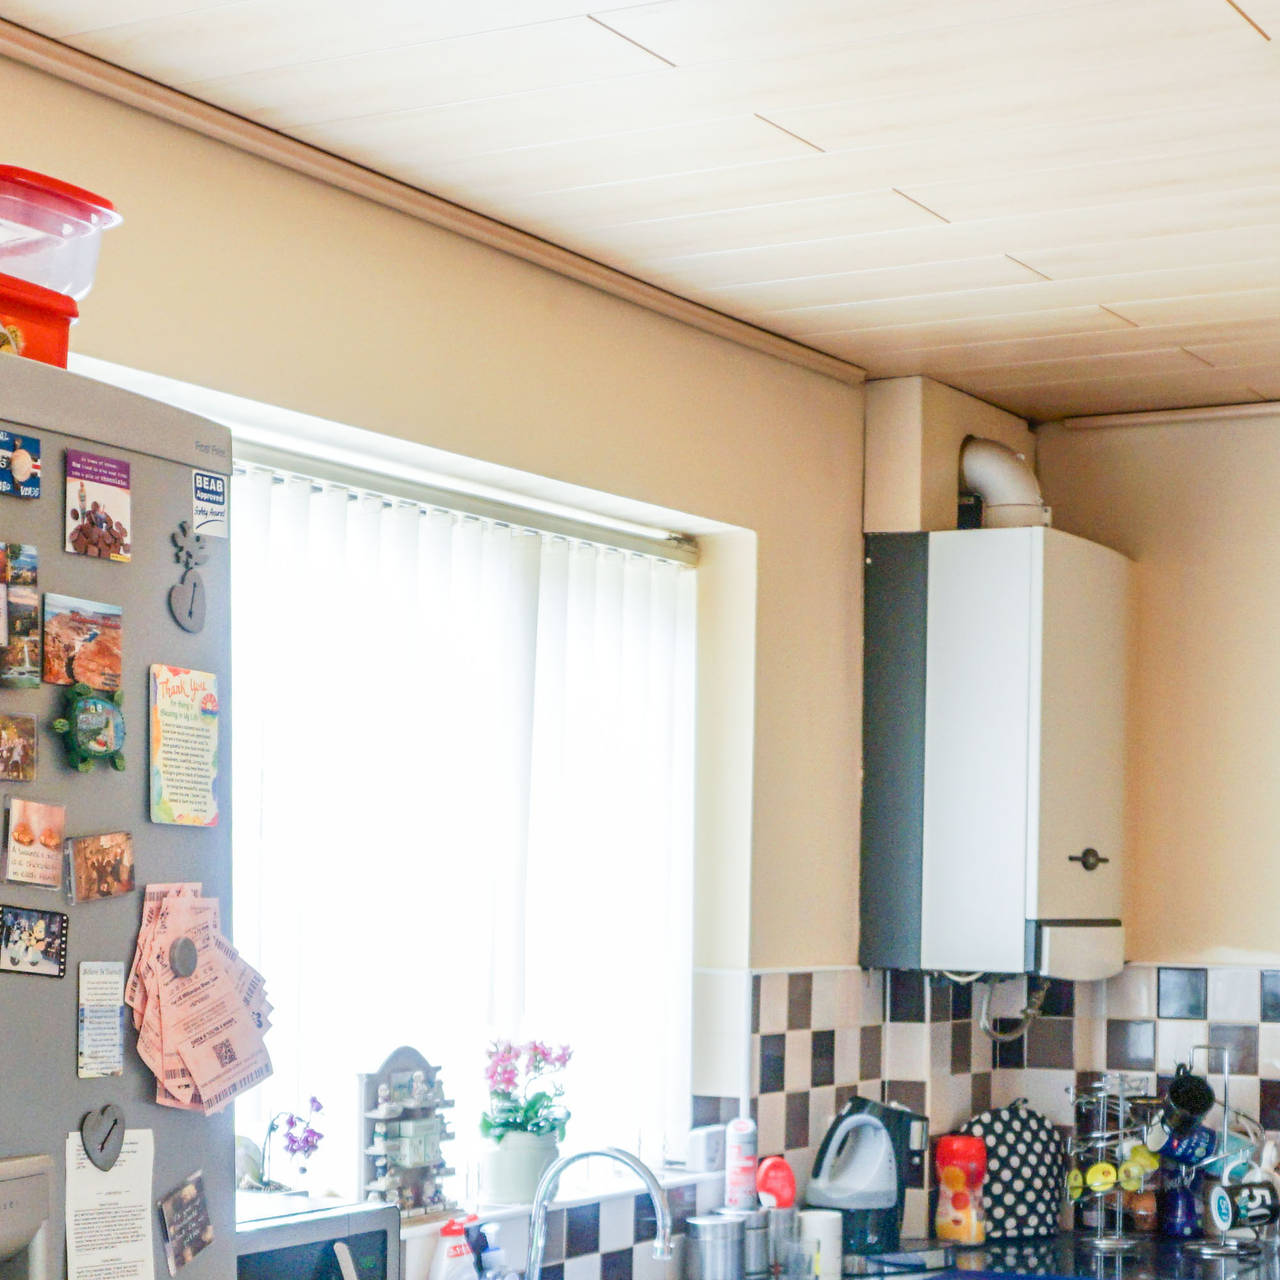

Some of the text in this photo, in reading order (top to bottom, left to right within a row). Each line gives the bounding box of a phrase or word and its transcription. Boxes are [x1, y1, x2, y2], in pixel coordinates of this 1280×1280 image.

[195, 475, 224, 492] BEAB
[196, 489, 223, 503] Approved
[160, 678, 207, 702] Thank You
